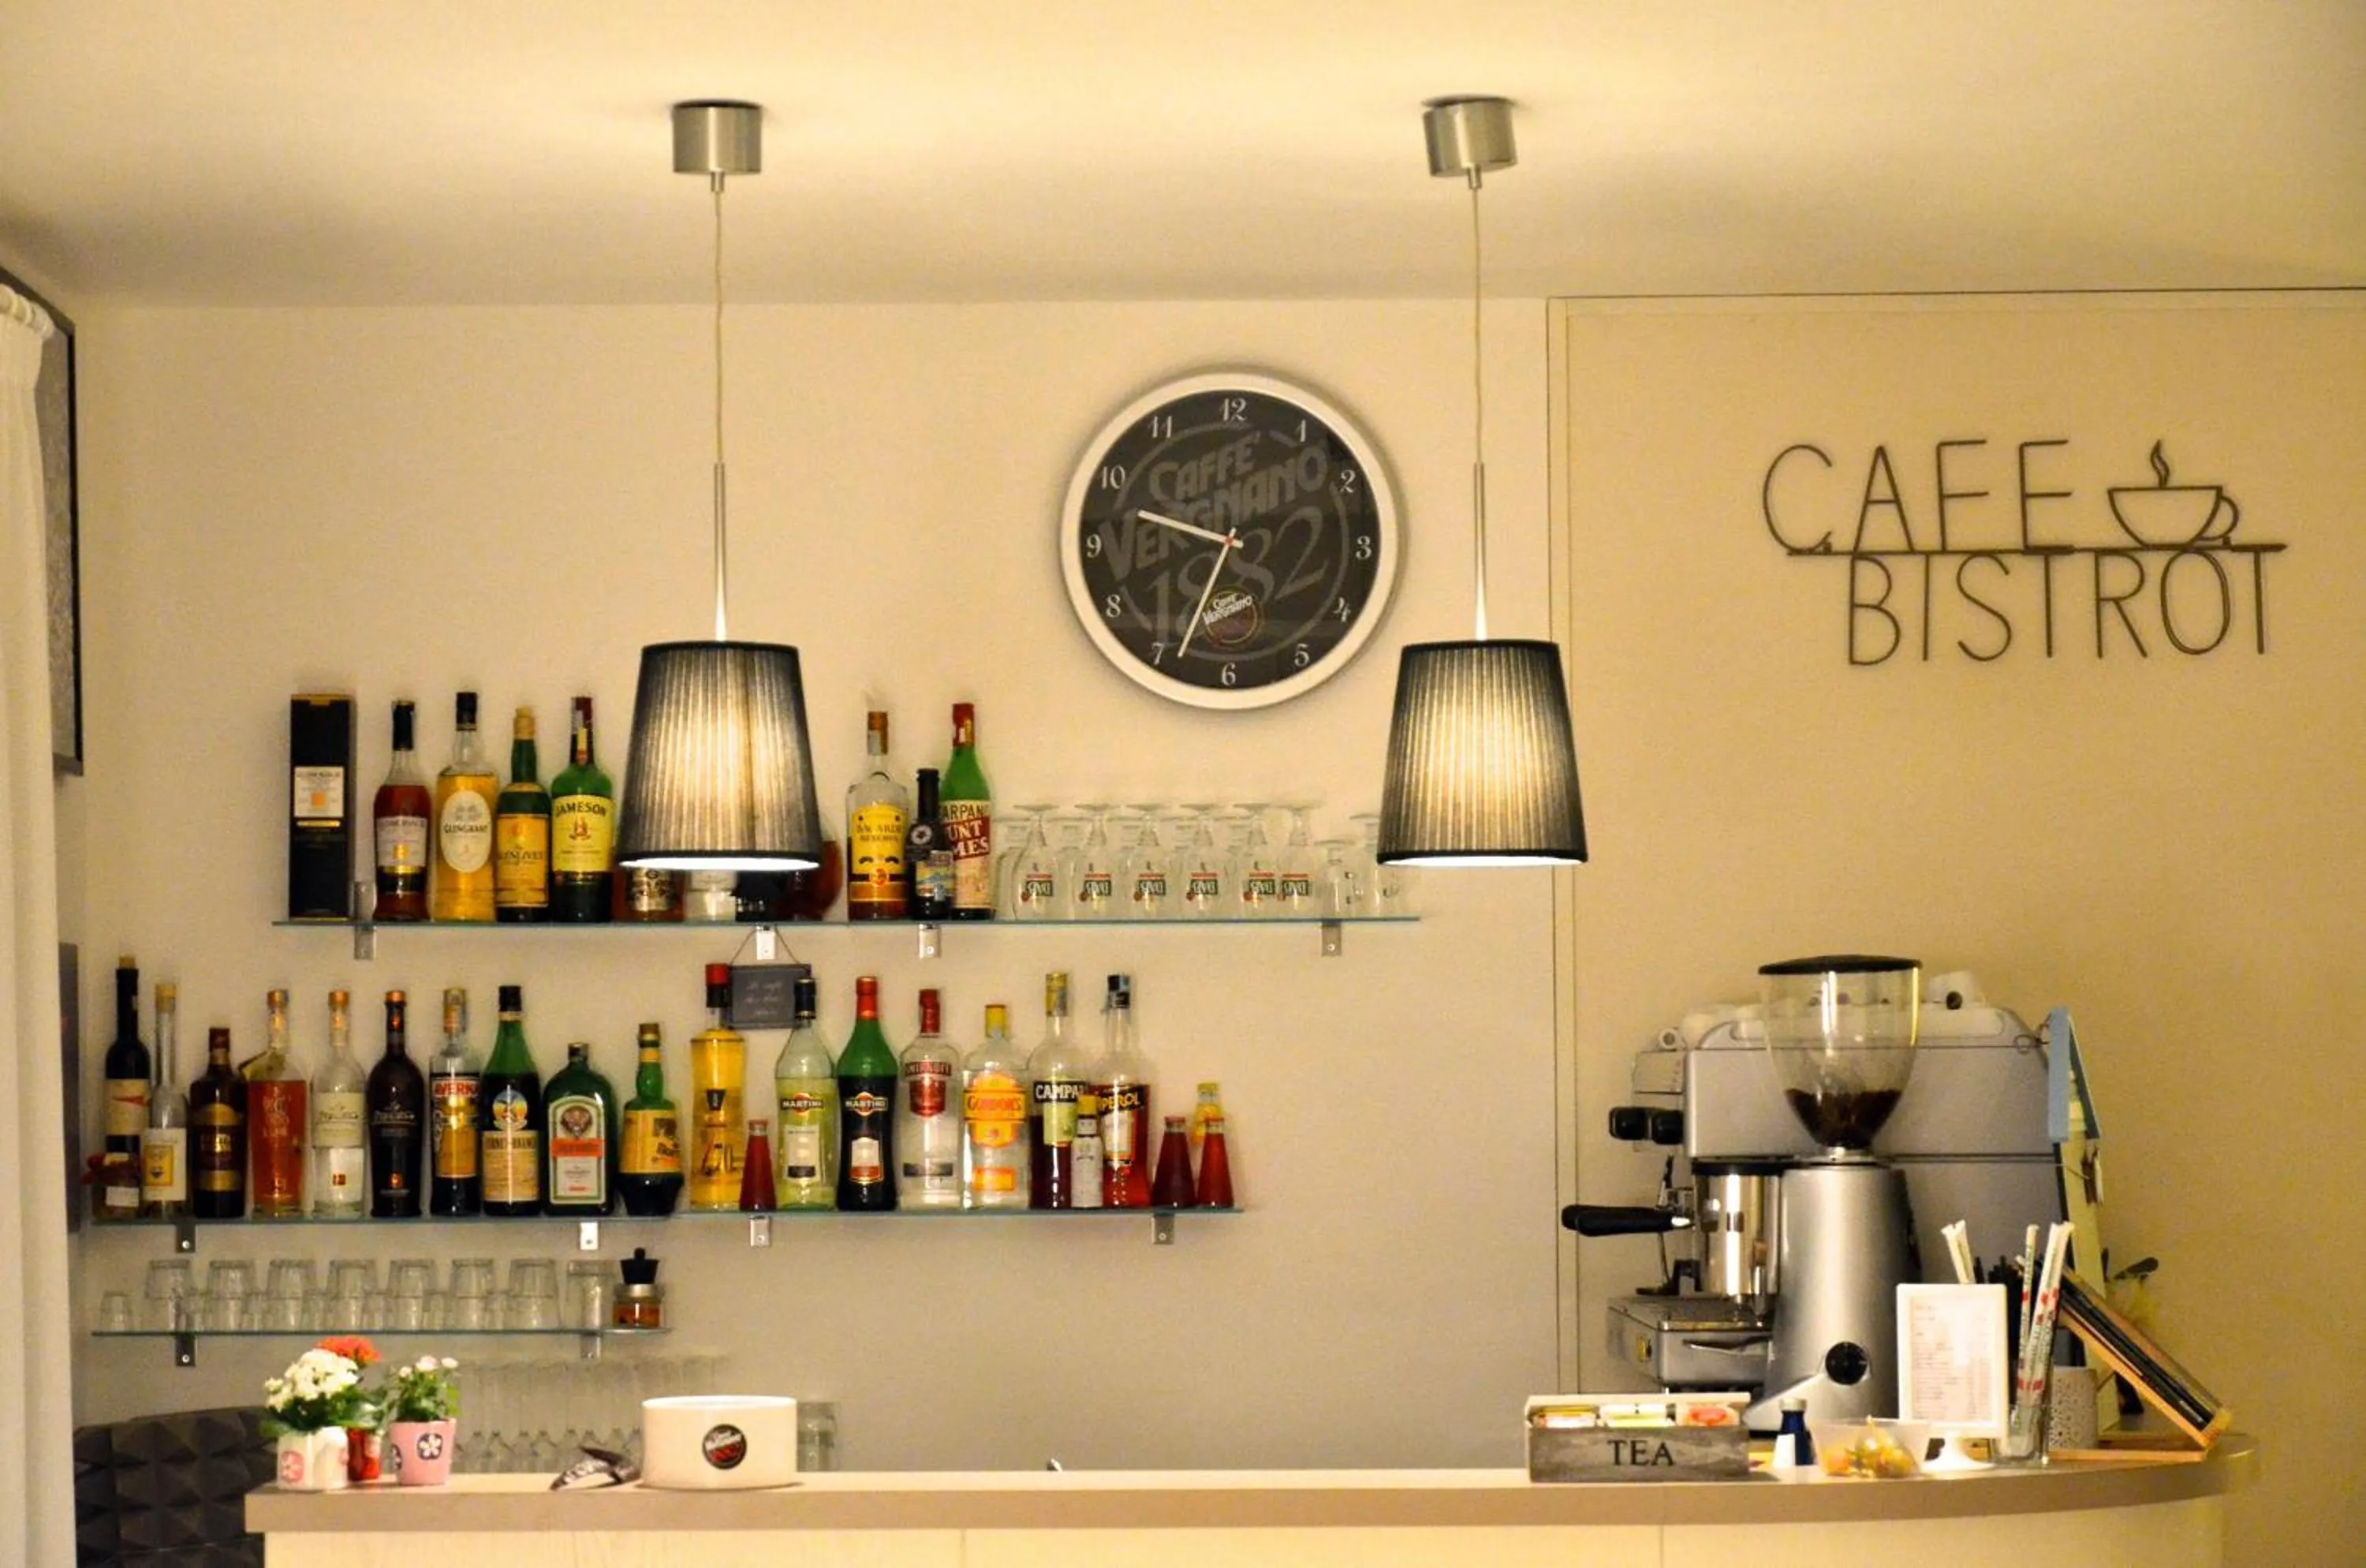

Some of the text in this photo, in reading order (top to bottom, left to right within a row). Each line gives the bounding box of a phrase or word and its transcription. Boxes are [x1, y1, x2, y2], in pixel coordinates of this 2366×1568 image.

[1222, 398, 1247, 422] 12
[1148, 416, 1173, 439] 11
[1297, 420, 1307, 442] 1
[1099, 465, 1126, 490] 10
[1340, 469, 1357, 493] 2
[1086, 534, 1102, 558] 9
[1356, 536, 1372, 560] 3
[1106, 594, 1121, 618] 8
[1333, 596, 1352, 623] 4
[1848, 543, 2286, 665] BISTROT
[1151, 642, 1163, 666] 7
[1294, 643, 1310, 667] 5
[1221, 662, 1237, 686] 6
[556, 800, 606, 818] JAMESON
[947, 820, 983, 842] UNT
[782, 1099, 822, 1108] MARTINI
[1036, 1085, 1084, 1099] CAMPA
[1607, 1439, 1676, 1466] TEA
